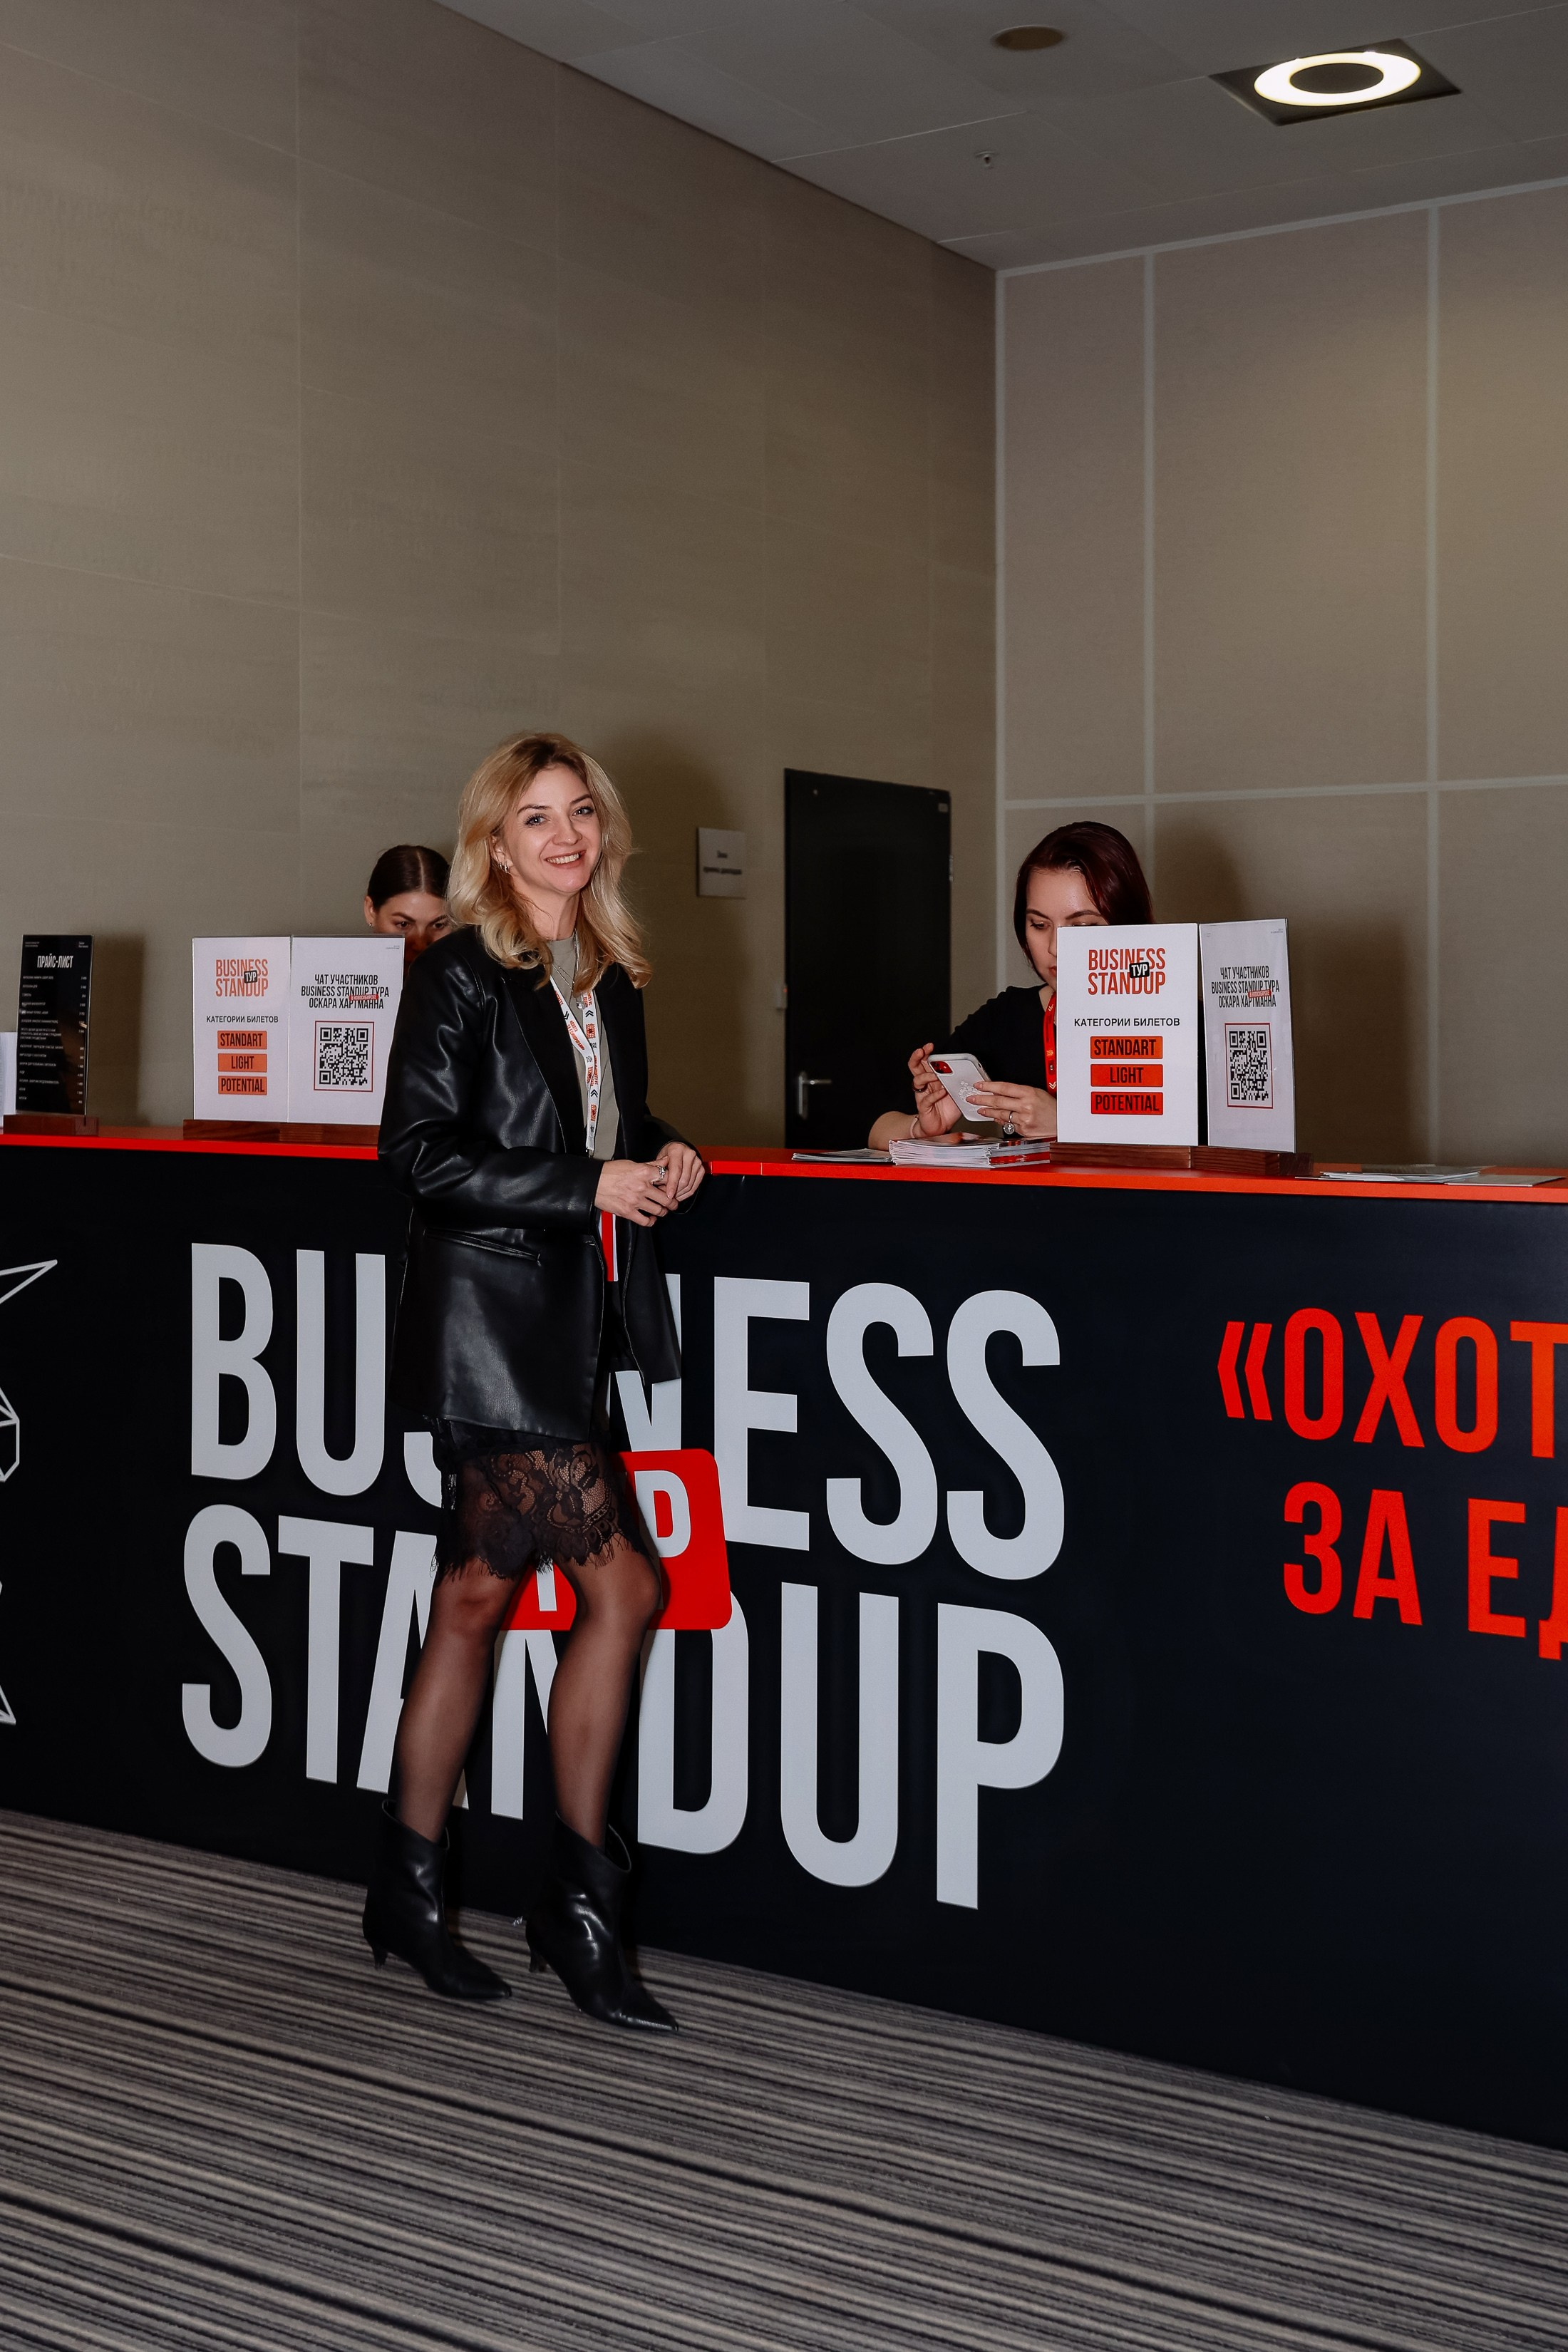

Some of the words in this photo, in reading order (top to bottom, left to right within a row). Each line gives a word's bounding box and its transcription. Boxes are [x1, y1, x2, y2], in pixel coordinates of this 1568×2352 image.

[37, 953, 73, 969] ПРАЙС-ЛИСТ
[1089, 948, 1165, 970] BUSINESS
[216, 959, 268, 976] BUSINESS
[1131, 964, 1147, 976] ТУР
[1220, 967, 1231, 979] ЧАТ
[1232, 966, 1269, 979] УЧАСТНИКОВ
[245, 971, 257, 982] ТУР
[315, 974, 329, 985] ЧАТ
[331, 974, 378, 985] УЧАСТНИКОВ
[1088, 971, 1165, 995] STANDUP
[216, 978, 268, 996] STANDUP
[301, 986, 335, 996] BUSINESS
[337, 986, 369, 996] STANDUP
[371, 986, 389, 997] ТУРА
[1212, 981, 1237, 994] BUSINESS
[1238, 981, 1263, 993] STANDUP
[1264, 980, 1280, 993] ТУРА
[309, 998, 337, 1008] ОСКАРА
[339, 998, 384, 1009] ХАРТМАННА
[1219, 995, 1241, 1008] ОСКАРА
[1242, 994, 1276, 1008] ХАРТМАННА
[1074, 1018, 1131, 1027] КАТЕГОРИИ
[1134, 1018, 1180, 1026] БИЛЕТОВ
[220, 1033, 263, 1047] STANDART
[1094, 1039, 1157, 1056] STANDART
[231, 1056, 254, 1069] LIGHT
[1110, 1067, 1144, 1083] LIGHT
[221, 1078, 264, 1093] POTENTIAL
[1095, 1095, 1160, 1111] POTENTIAL
[1283, 1481, 1423, 1626] ЗА
